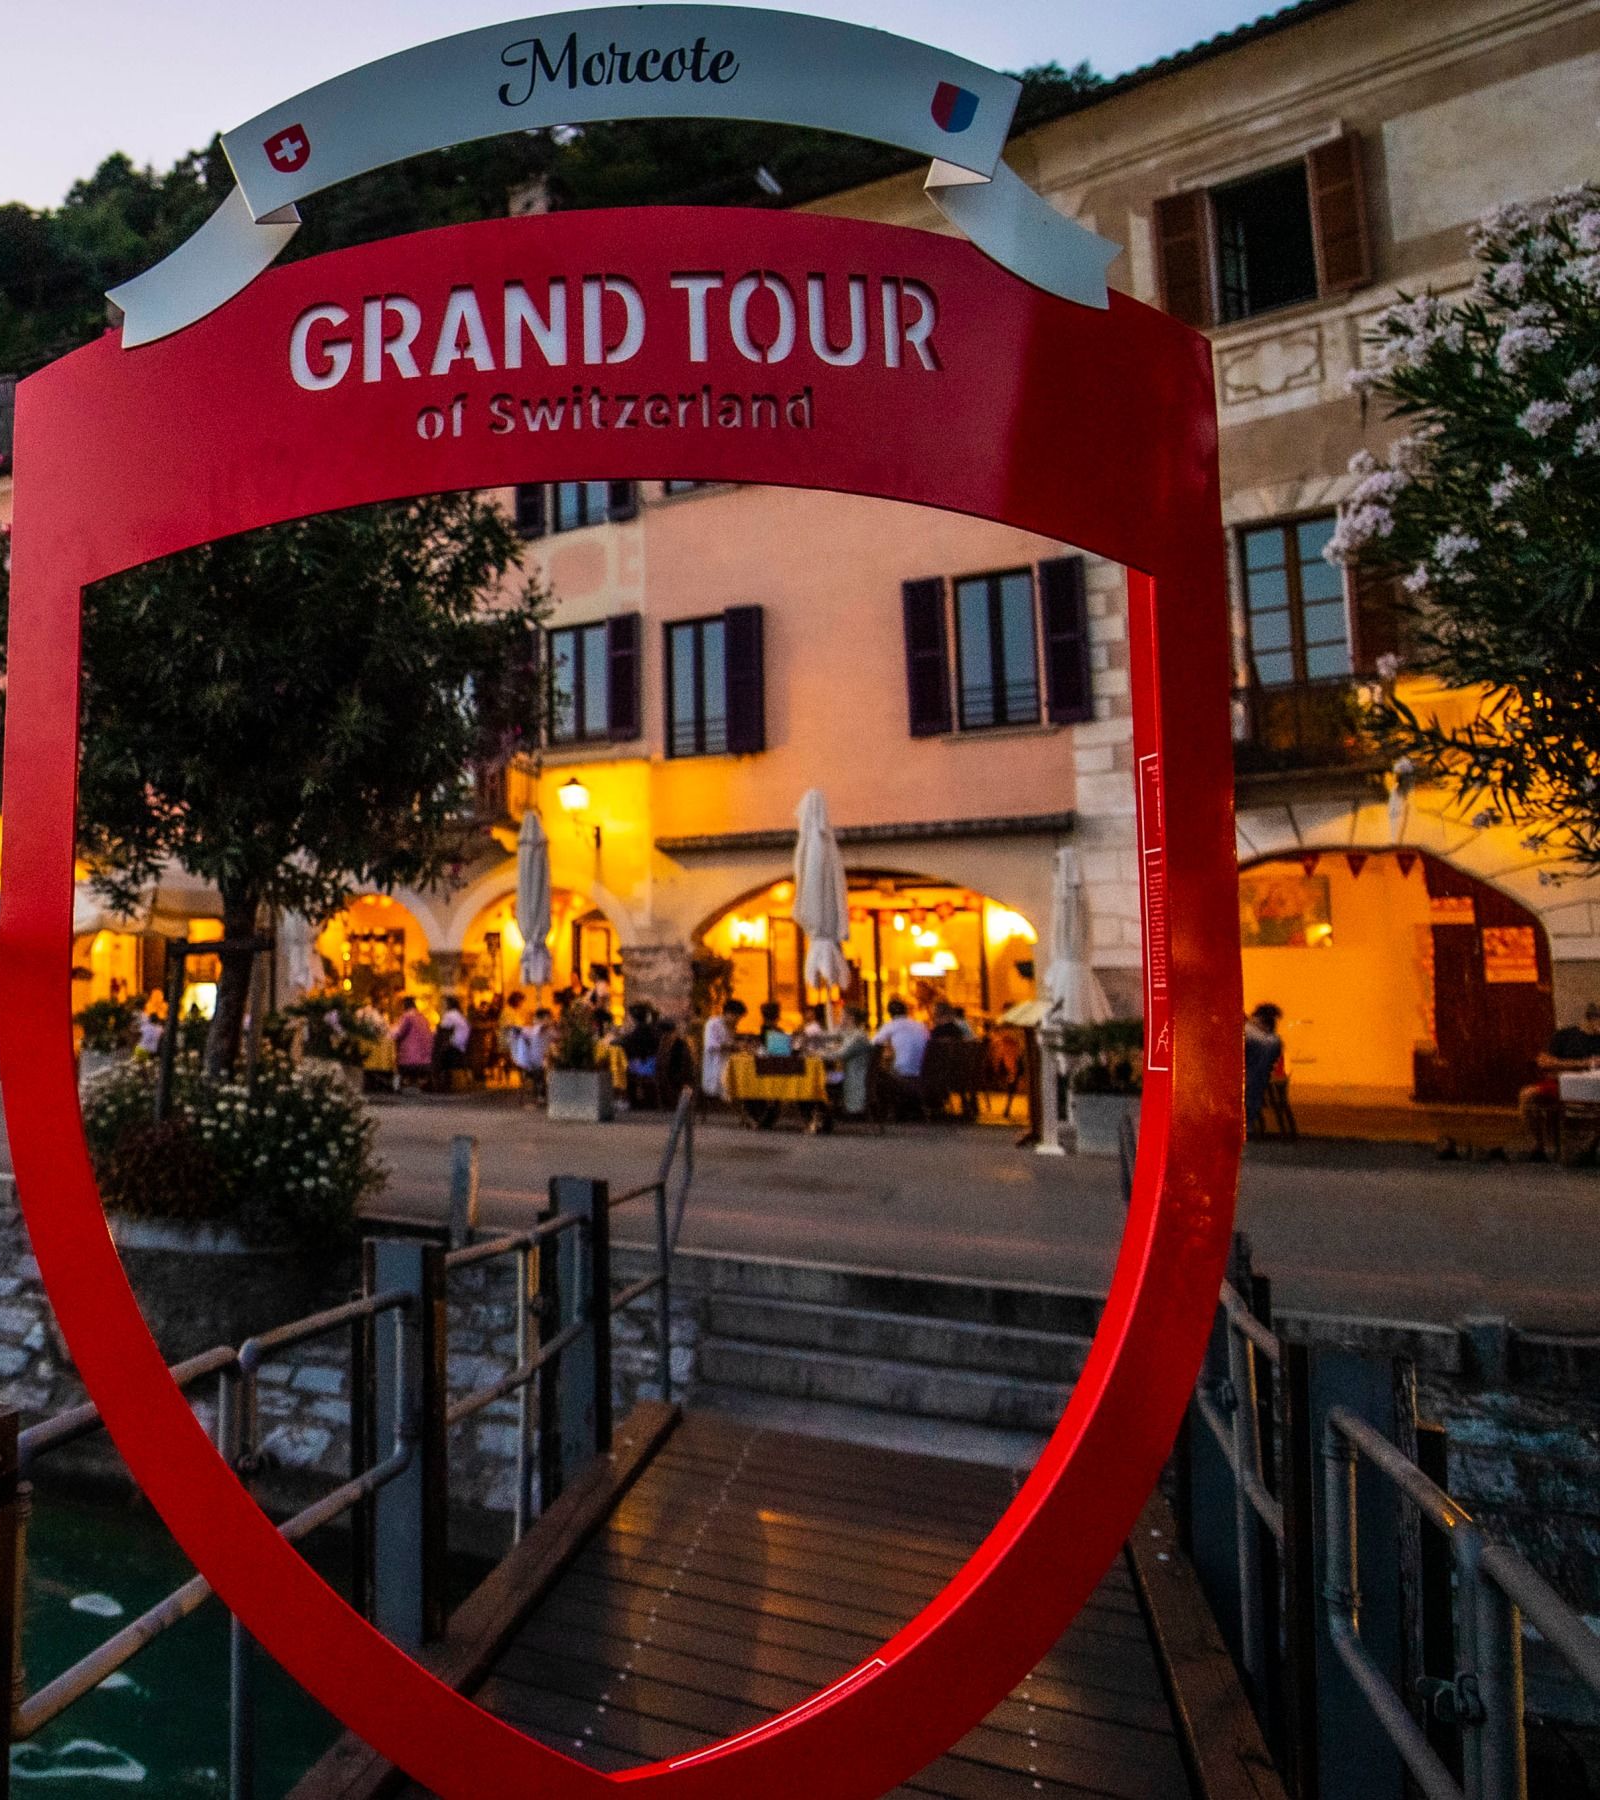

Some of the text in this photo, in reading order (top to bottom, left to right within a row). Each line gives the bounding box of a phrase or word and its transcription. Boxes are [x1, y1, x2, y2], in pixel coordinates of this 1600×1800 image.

[498, 32, 740, 107] Morcote
[289, 268, 944, 391] GRAND TOUR
[416, 384, 814, 440] of Switzerland
